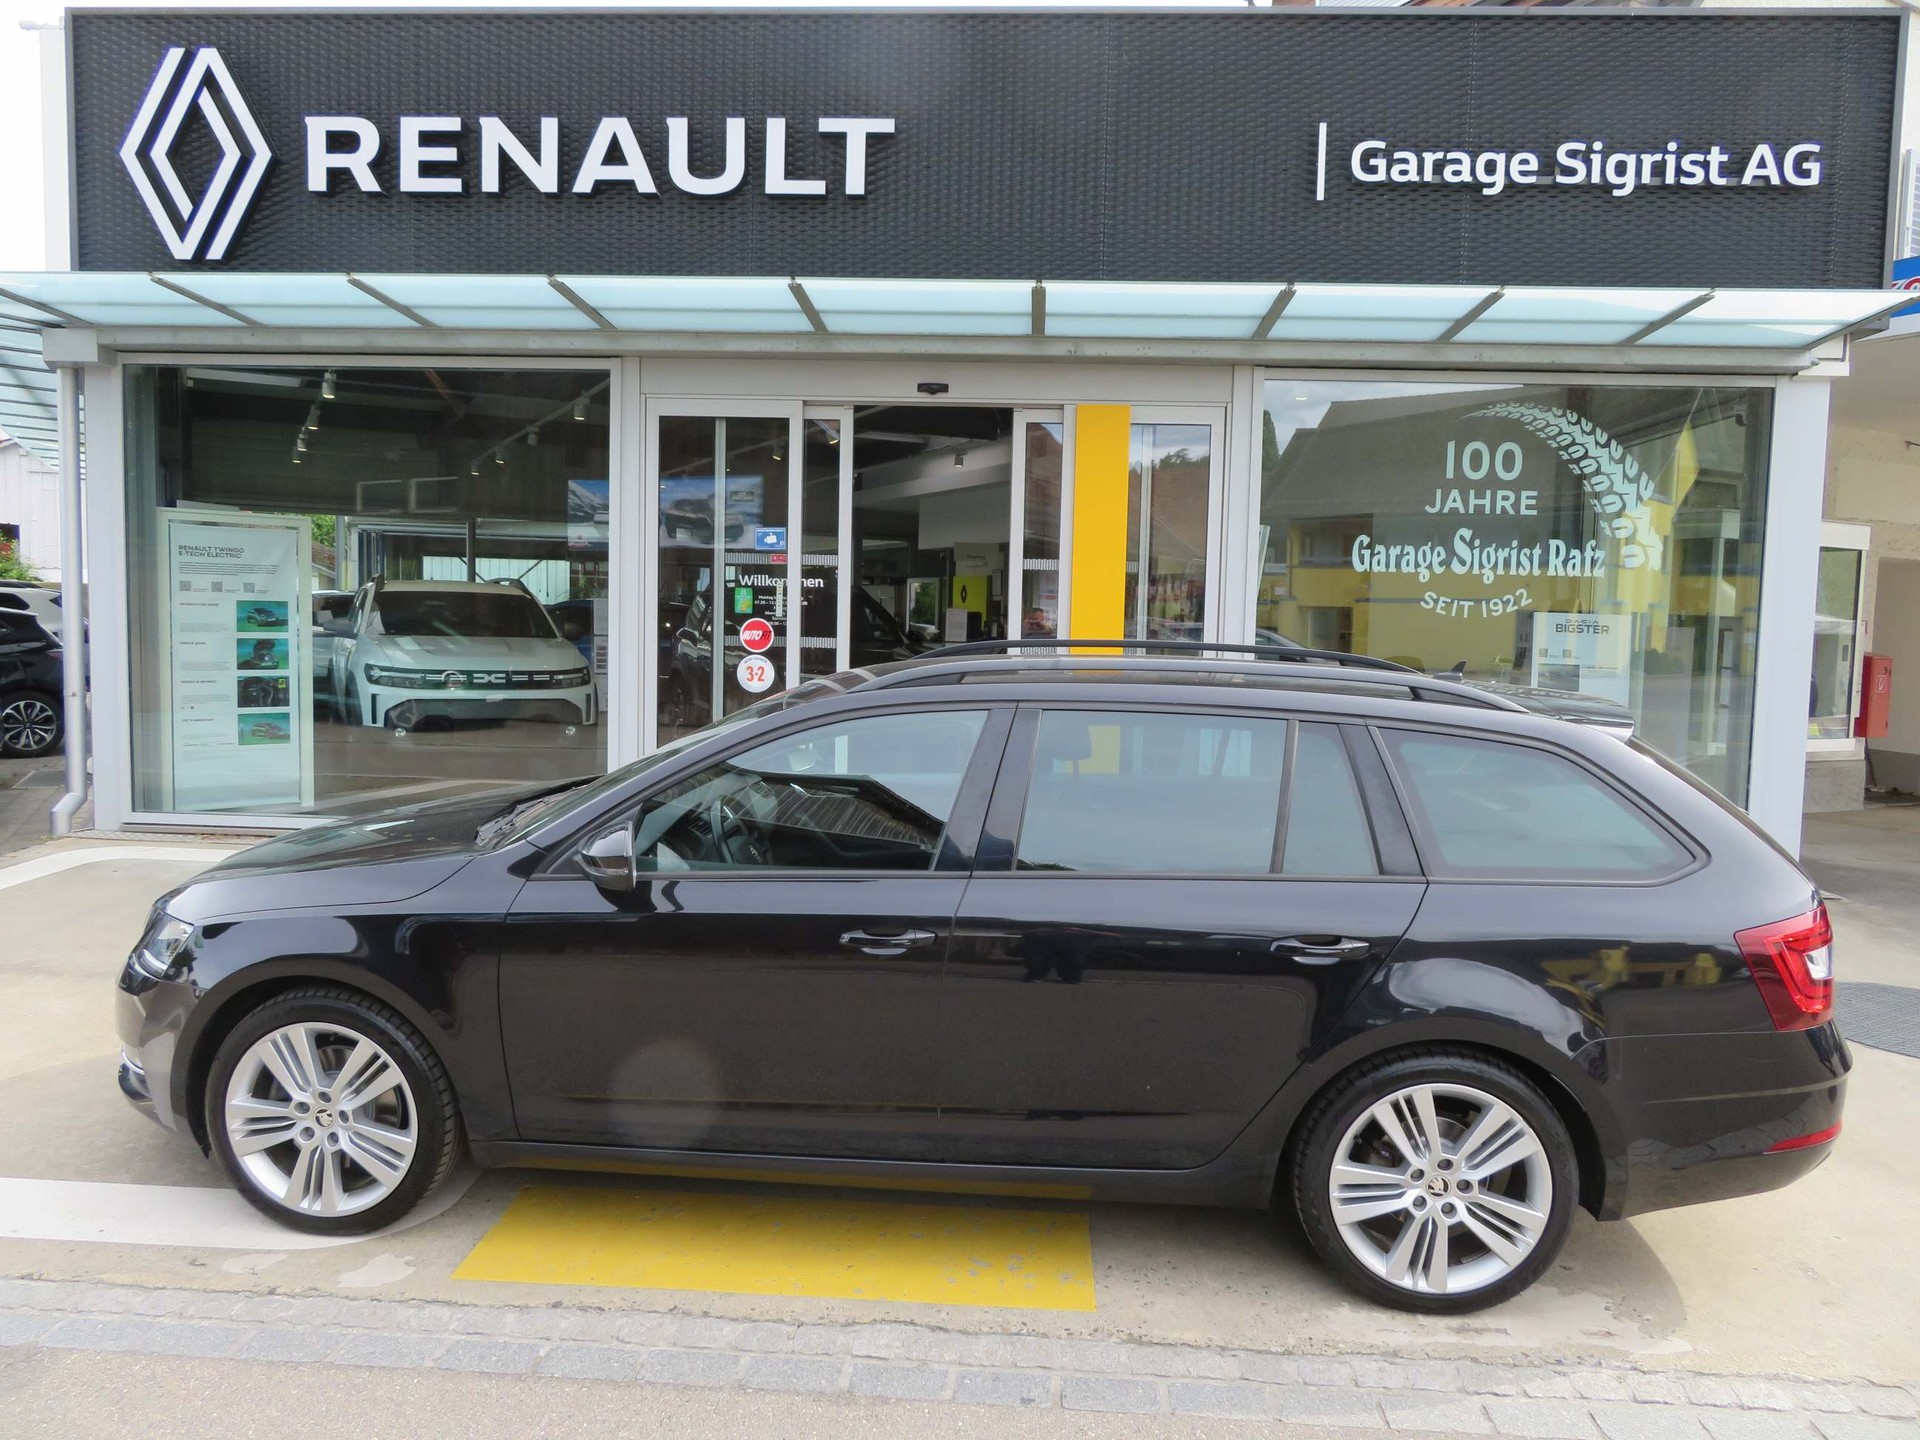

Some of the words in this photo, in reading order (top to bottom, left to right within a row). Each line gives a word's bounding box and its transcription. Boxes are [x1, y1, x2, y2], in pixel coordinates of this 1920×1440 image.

[304, 115, 896, 197] RENAULT
[1350, 139, 1539, 196] Garage
[1554, 140, 1731, 197] Sigrist
[1741, 142, 1822, 187] AG
[1445, 440, 1524, 482] 100
[1424, 488, 1539, 516] JAHRE
[178, 544, 212, 552] RENAULT
[213, 546, 245, 554] TWINGO
[1351, 534, 1446, 583] Garage
[1450, 527, 1542, 584] Sigrist
[1546, 539, 1606, 578] Rafz
[1420, 591, 1476, 619] SEIT
[1481, 587, 1533, 618] 1922
[1555, 623, 1611, 635] BIGSTER
